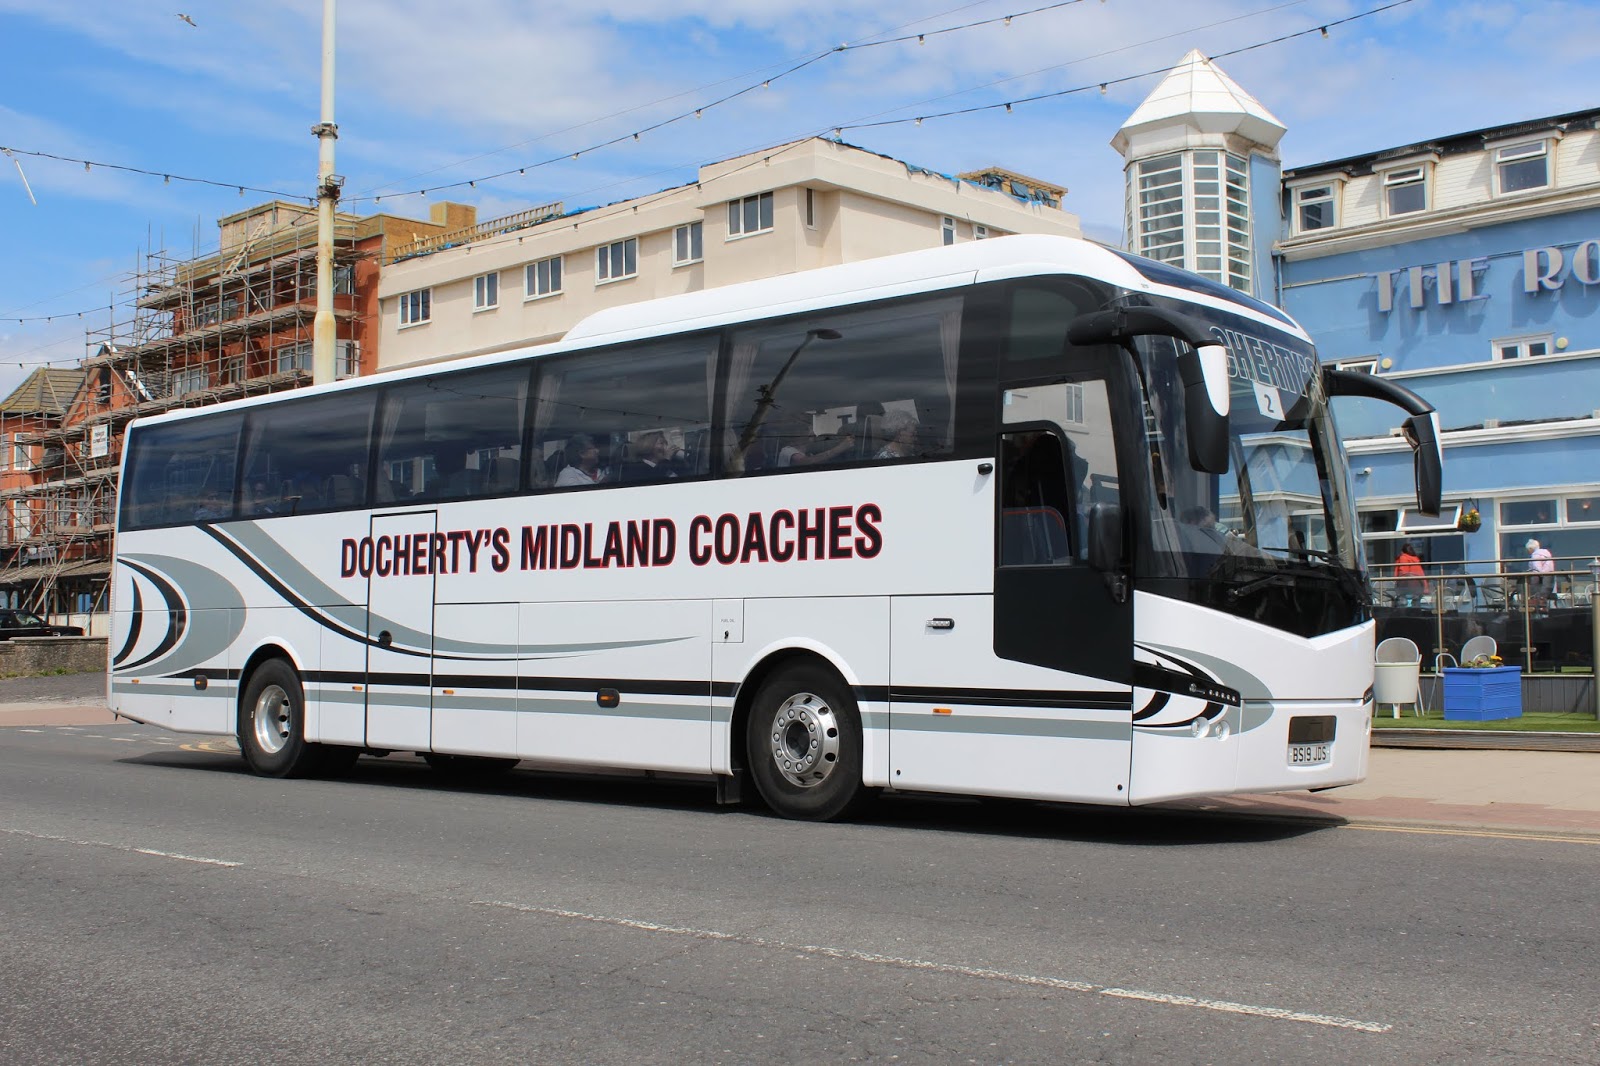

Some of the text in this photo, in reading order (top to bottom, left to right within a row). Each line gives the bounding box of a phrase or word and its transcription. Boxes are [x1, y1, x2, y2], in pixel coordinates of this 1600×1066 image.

[1366, 256, 1491, 312] THE
[1264, 394, 1274, 413] 2
[341, 503, 882, 578] DOCHERTY'S MIDLAND COACHES
[1293, 747, 1311, 762] BS19
